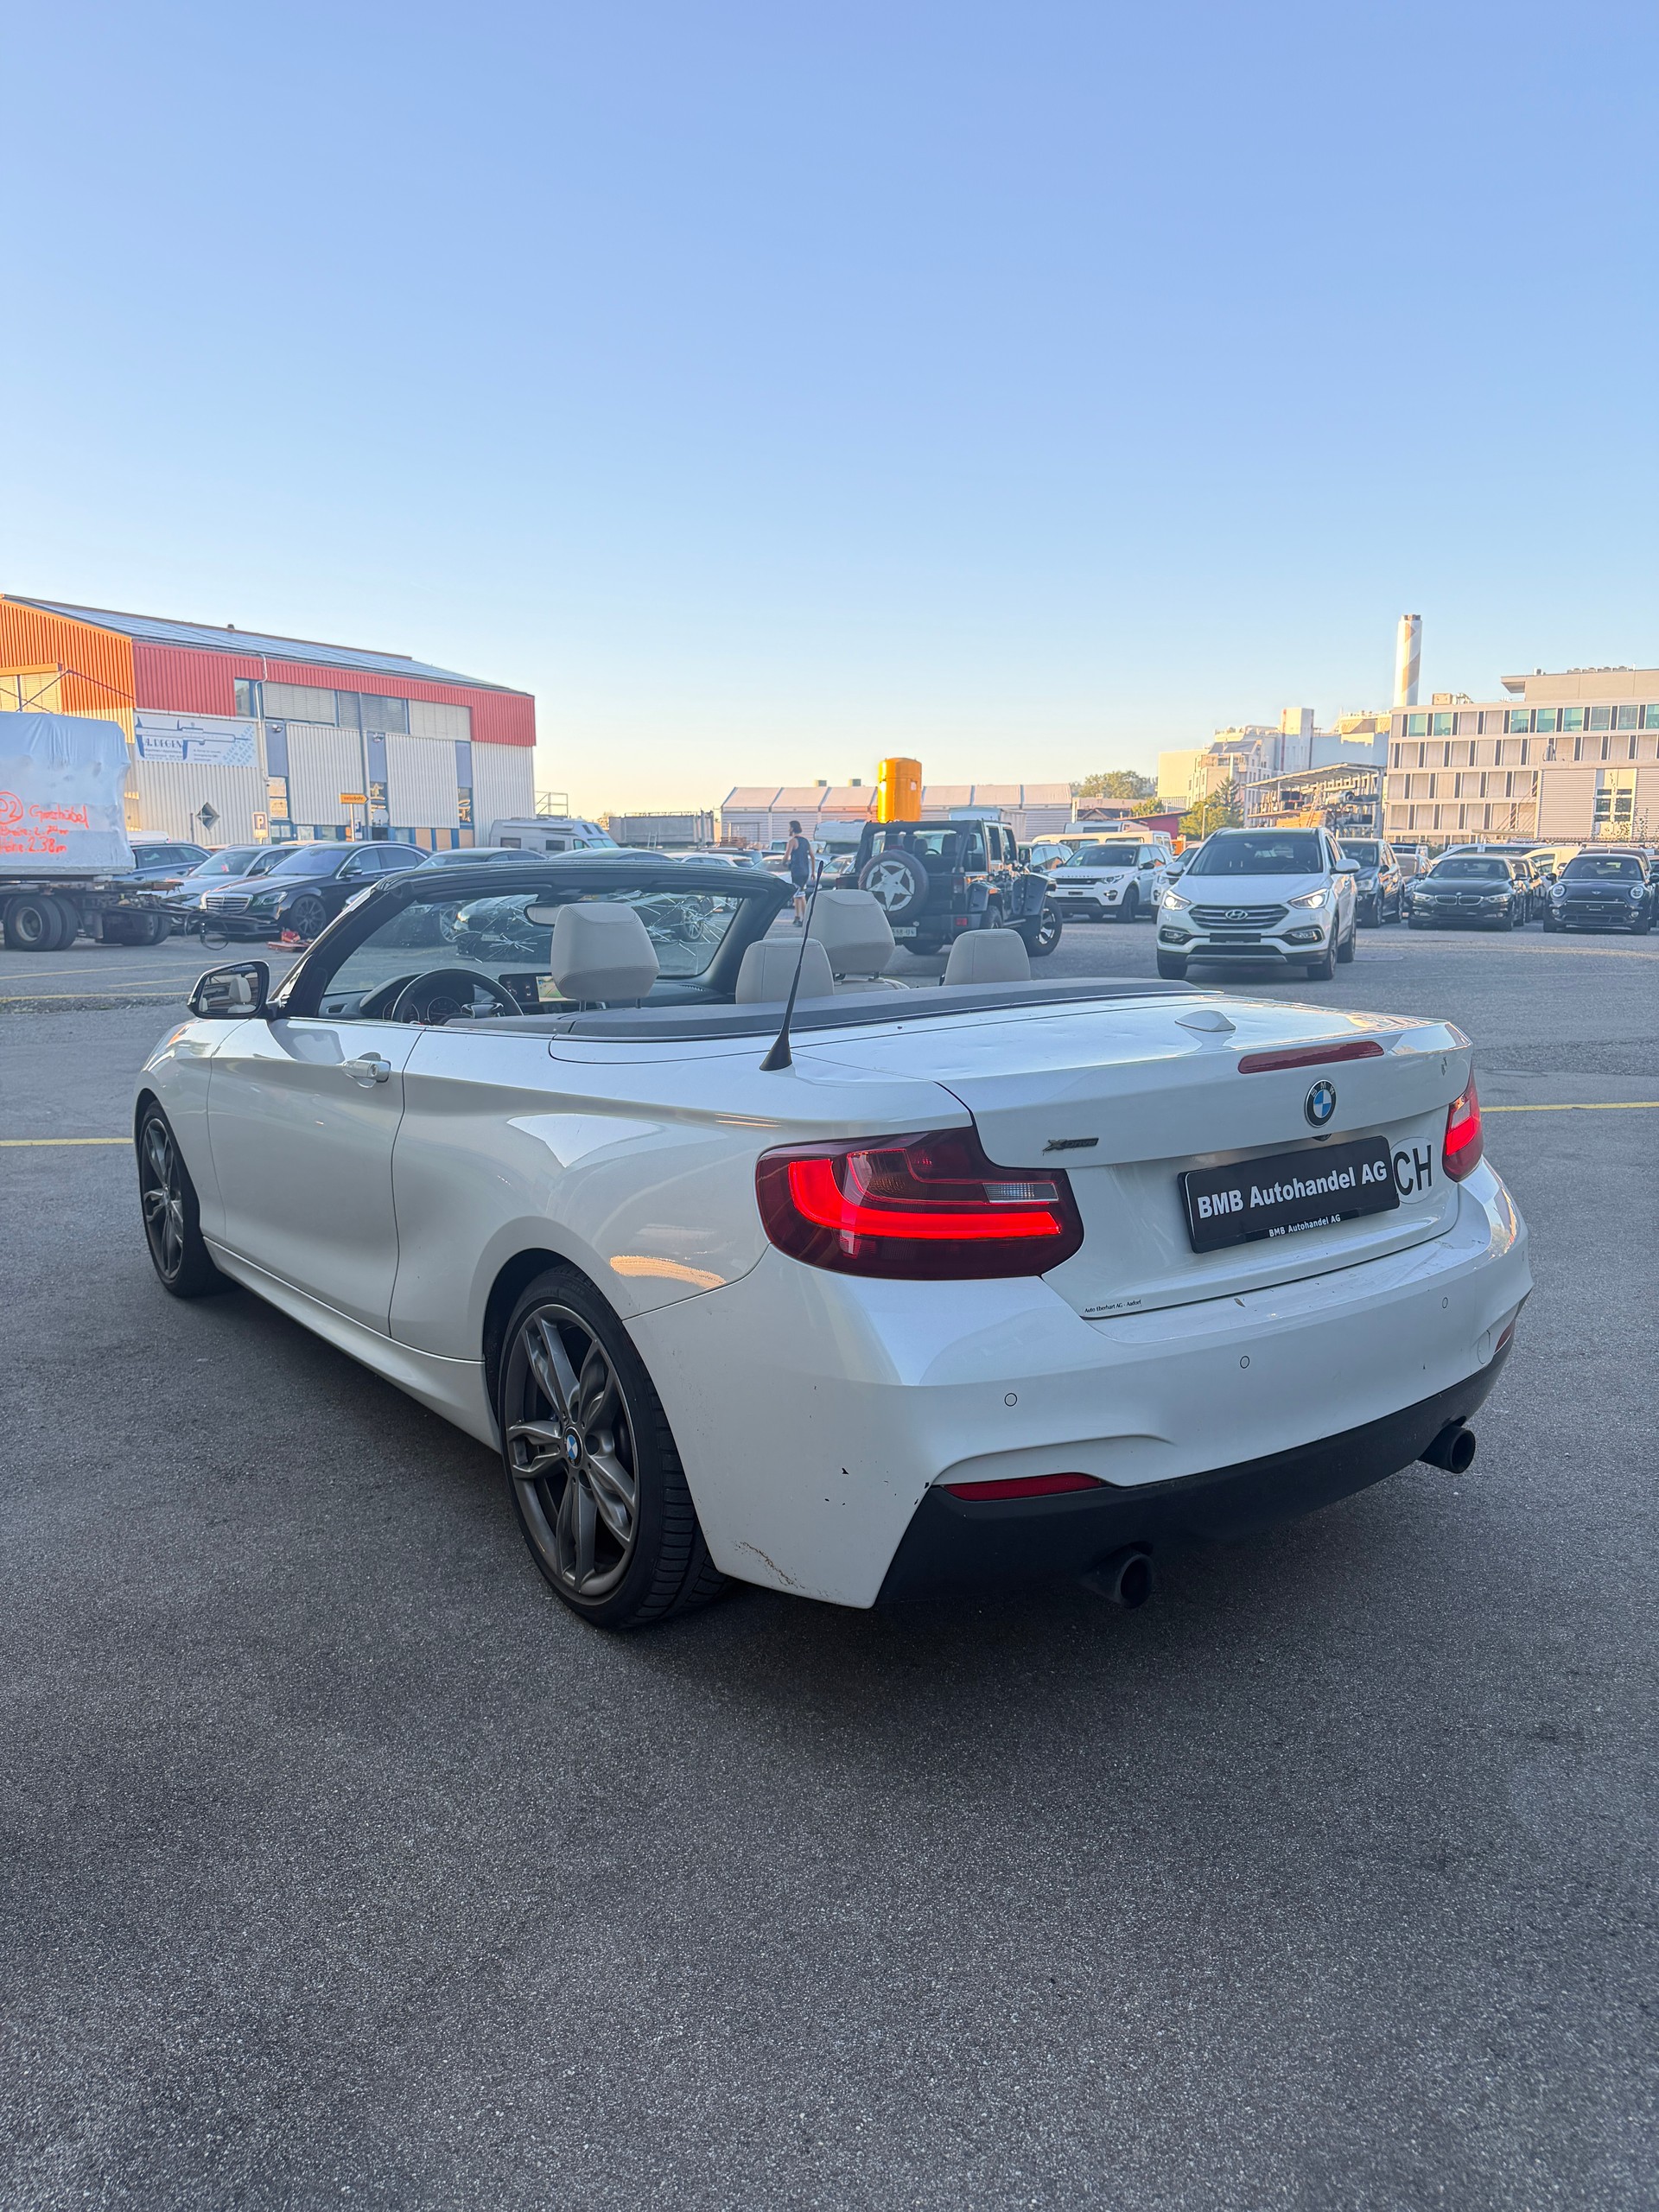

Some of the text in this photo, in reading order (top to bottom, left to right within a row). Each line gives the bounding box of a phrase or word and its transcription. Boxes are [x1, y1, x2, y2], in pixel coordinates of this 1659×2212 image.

[1310, 1081, 1335, 1097] BMW
[1198, 1160, 1388, 1219] BMB Autohandel AG
[1393, 1144, 1433, 1197] CH
[1268, 1213, 1341, 1237] BMB Autohandel AG
